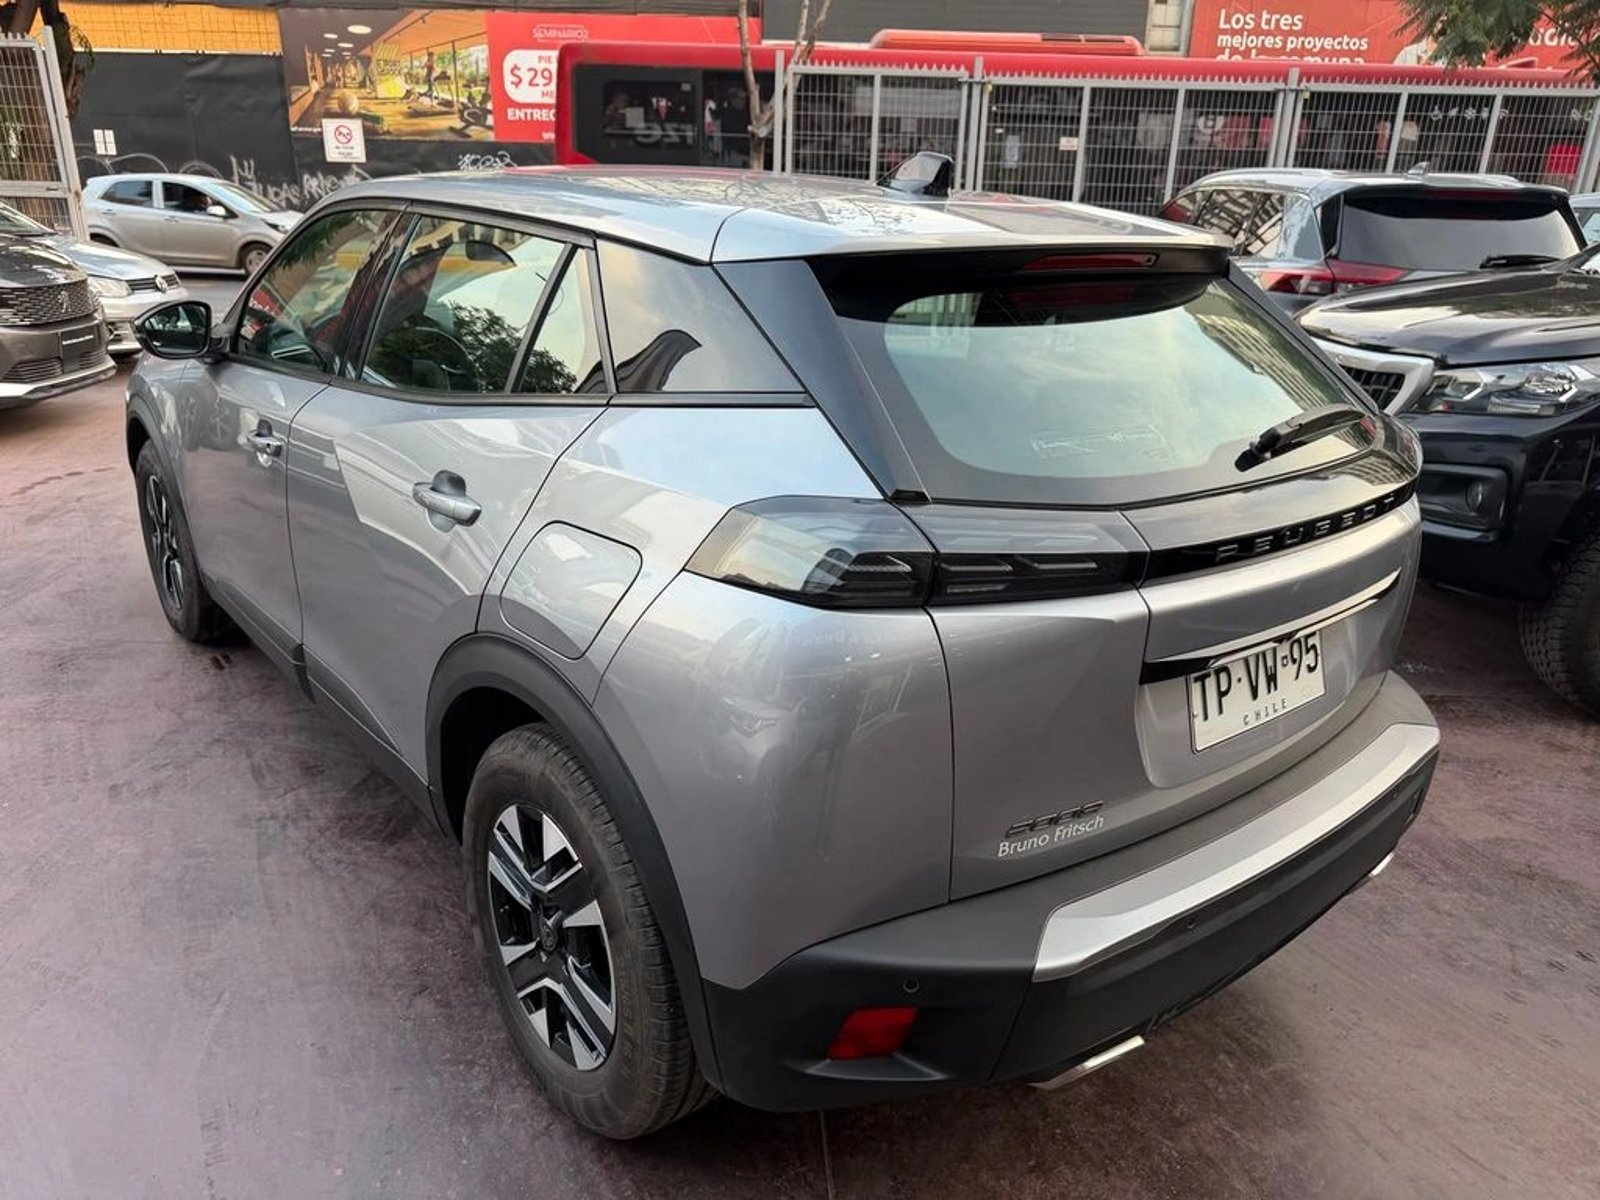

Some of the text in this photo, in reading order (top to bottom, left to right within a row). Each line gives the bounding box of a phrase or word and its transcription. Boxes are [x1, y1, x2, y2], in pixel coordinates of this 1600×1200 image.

[1218, 9, 1304, 31] Los tres
[1216, 31, 1369, 53] mejores proyectos
[1242, 697, 1286, 726] CHILE
[997, 815, 1104, 857] Bruno Fritsch
